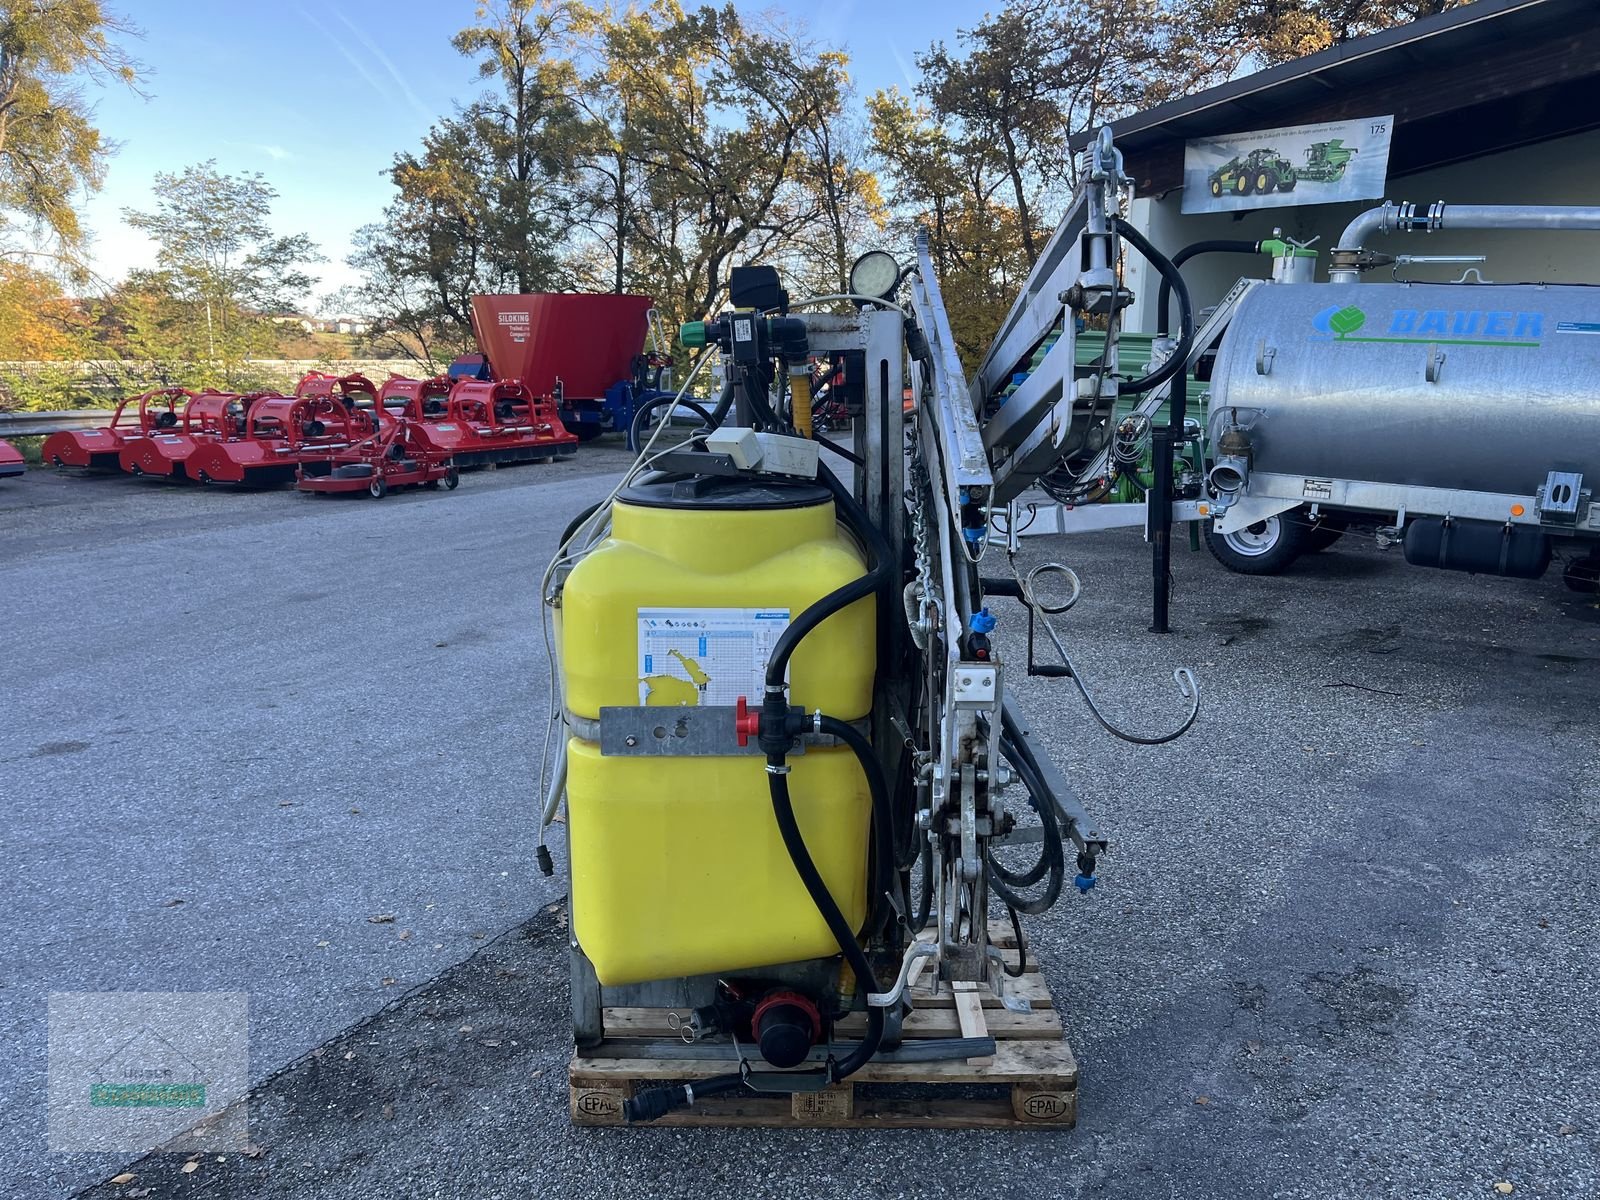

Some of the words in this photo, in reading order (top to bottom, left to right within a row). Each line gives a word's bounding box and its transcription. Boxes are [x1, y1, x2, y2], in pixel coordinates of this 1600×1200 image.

[1370, 124, 1386, 135] 175
[498, 314, 530, 323] SILOKING
[1388, 310, 1544, 337] BAUER
[585, 1097, 616, 1111] EPAL
[1030, 1100, 1060, 1114] EPAL
